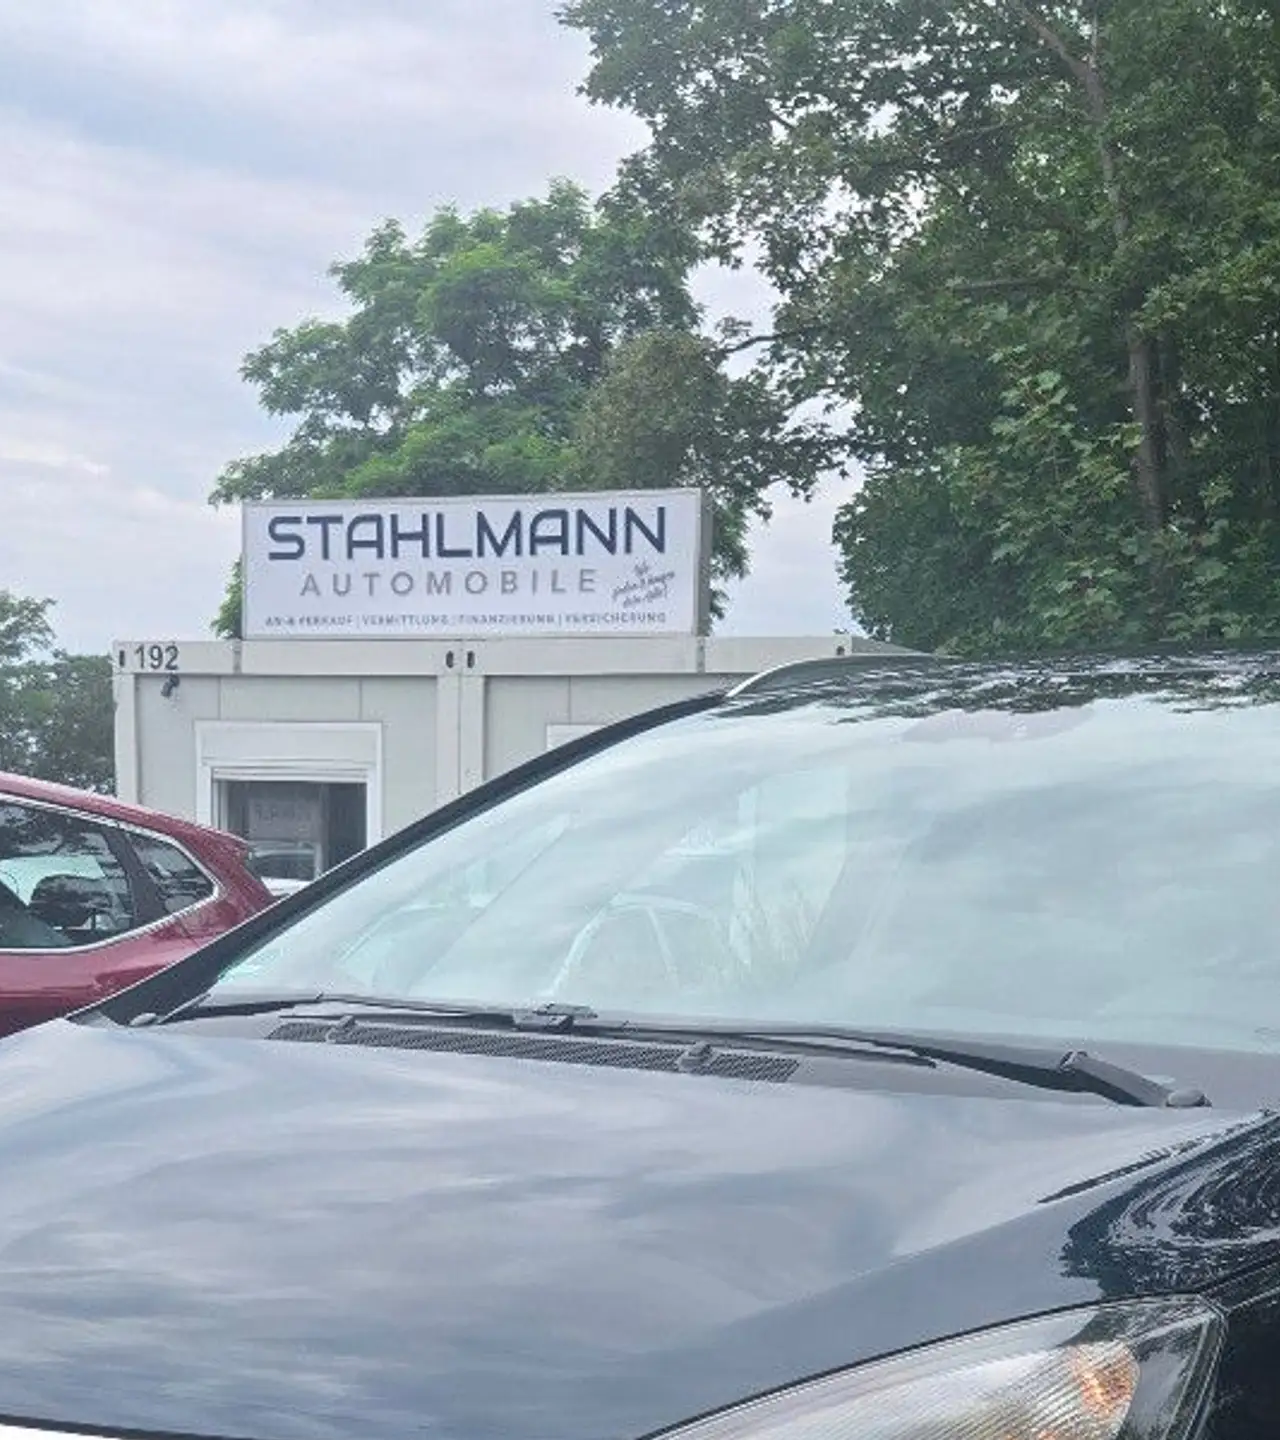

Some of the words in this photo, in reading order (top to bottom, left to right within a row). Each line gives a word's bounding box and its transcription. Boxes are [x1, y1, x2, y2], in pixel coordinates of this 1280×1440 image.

[267, 506, 666, 561] STAHLMANN
[300, 568, 597, 597] AUTOMOBILE
[134, 644, 180, 672] 192
